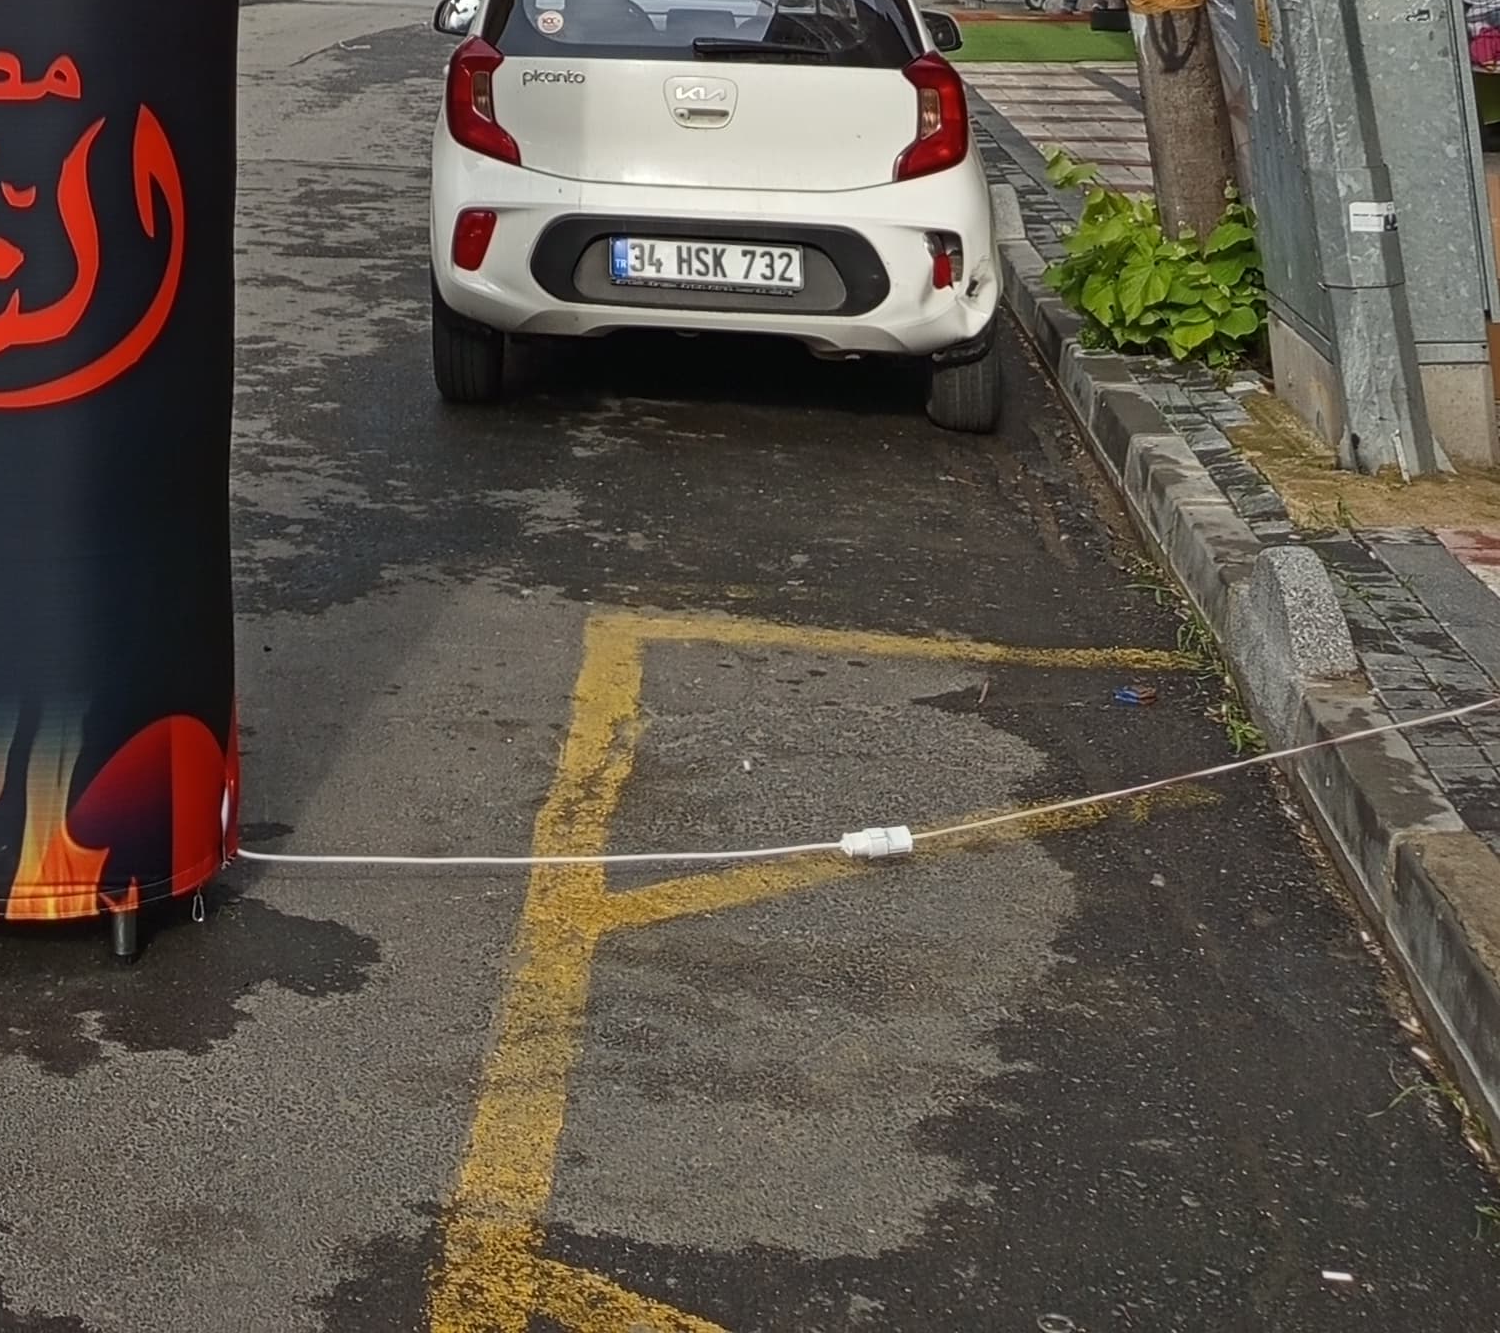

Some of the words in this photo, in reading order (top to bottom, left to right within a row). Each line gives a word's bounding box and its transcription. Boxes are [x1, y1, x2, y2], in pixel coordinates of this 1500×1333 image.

[522, 69, 586, 85] picanto
[675, 86, 727, 101] KIA
[615, 259, 627, 268] TR
[629, 242, 663, 273] 34
[676, 245, 727, 278] HSK
[741, 249, 794, 282] 732
